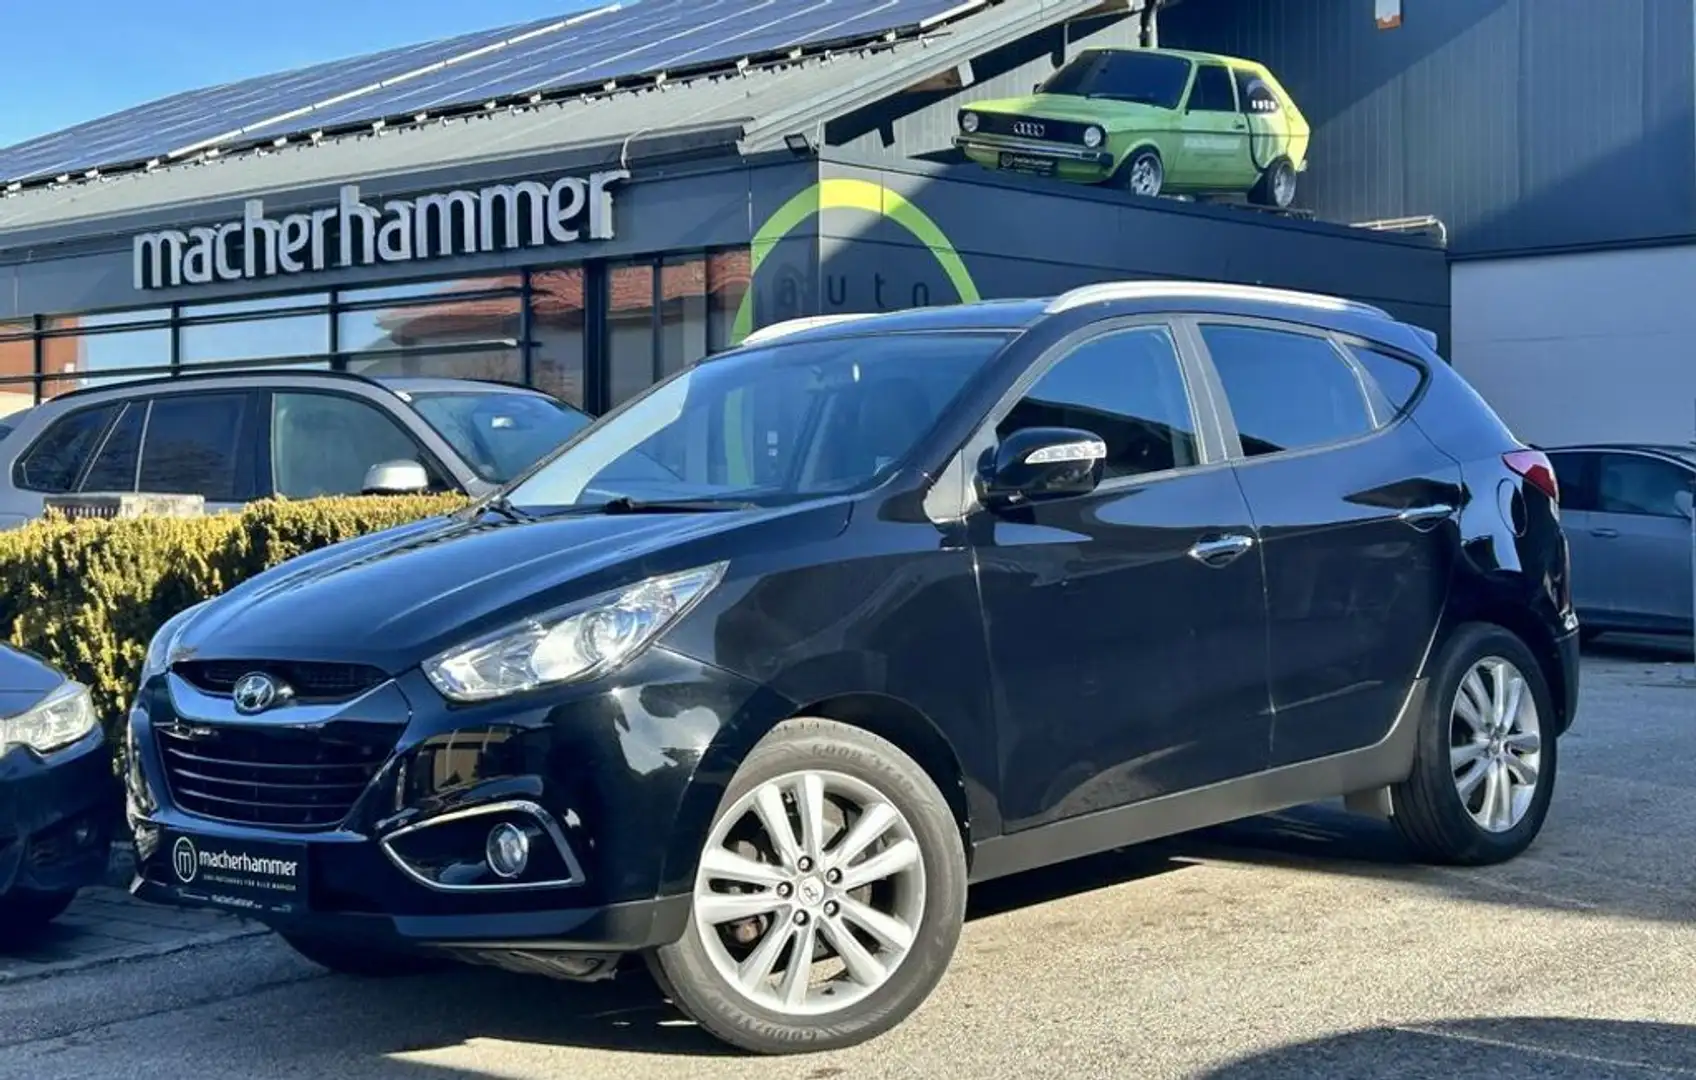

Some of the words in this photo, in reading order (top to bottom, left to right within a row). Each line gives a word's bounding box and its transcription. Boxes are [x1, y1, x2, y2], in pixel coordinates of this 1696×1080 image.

[133, 169, 631, 291] macherhammer
[776, 272, 931, 308] auto
[198, 850, 299, 877] macherhammer
